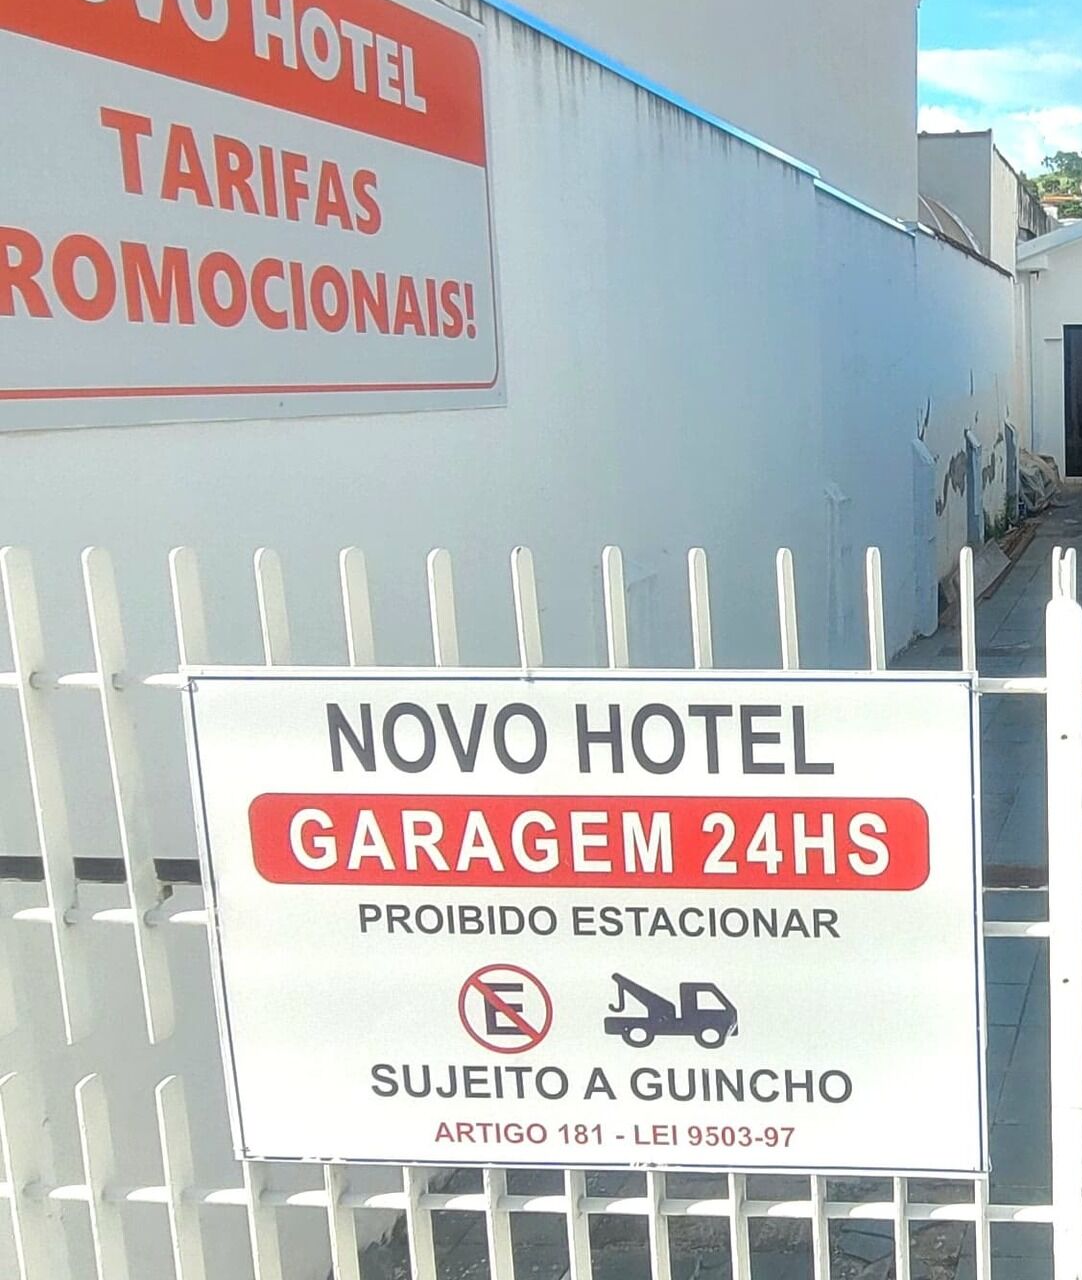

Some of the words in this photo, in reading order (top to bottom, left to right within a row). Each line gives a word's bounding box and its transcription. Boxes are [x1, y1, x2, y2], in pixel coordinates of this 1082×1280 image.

[100, 106, 382, 236] TARIFAS
[327, 702, 548, 775] NOVO
[576, 703, 835, 775] HOTEL
[288, 807, 674, 875] GARAGEM
[702, 811, 891, 877] 24HS
[359, 903, 557, 936] PROIBIDO
[572, 906, 841, 938] ESTACIONAR
[371, 1063, 569, 1100] SUJEITO
[583, 1067, 617, 1100] A
[630, 1067, 853, 1104] GUINCHO
[434, 1121, 548, 1144] ARTIGO
[558, 1123, 602, 1145] 181
[634, 1124, 678, 1146] LEI
[687, 1125, 795, 1148] 9503-97
